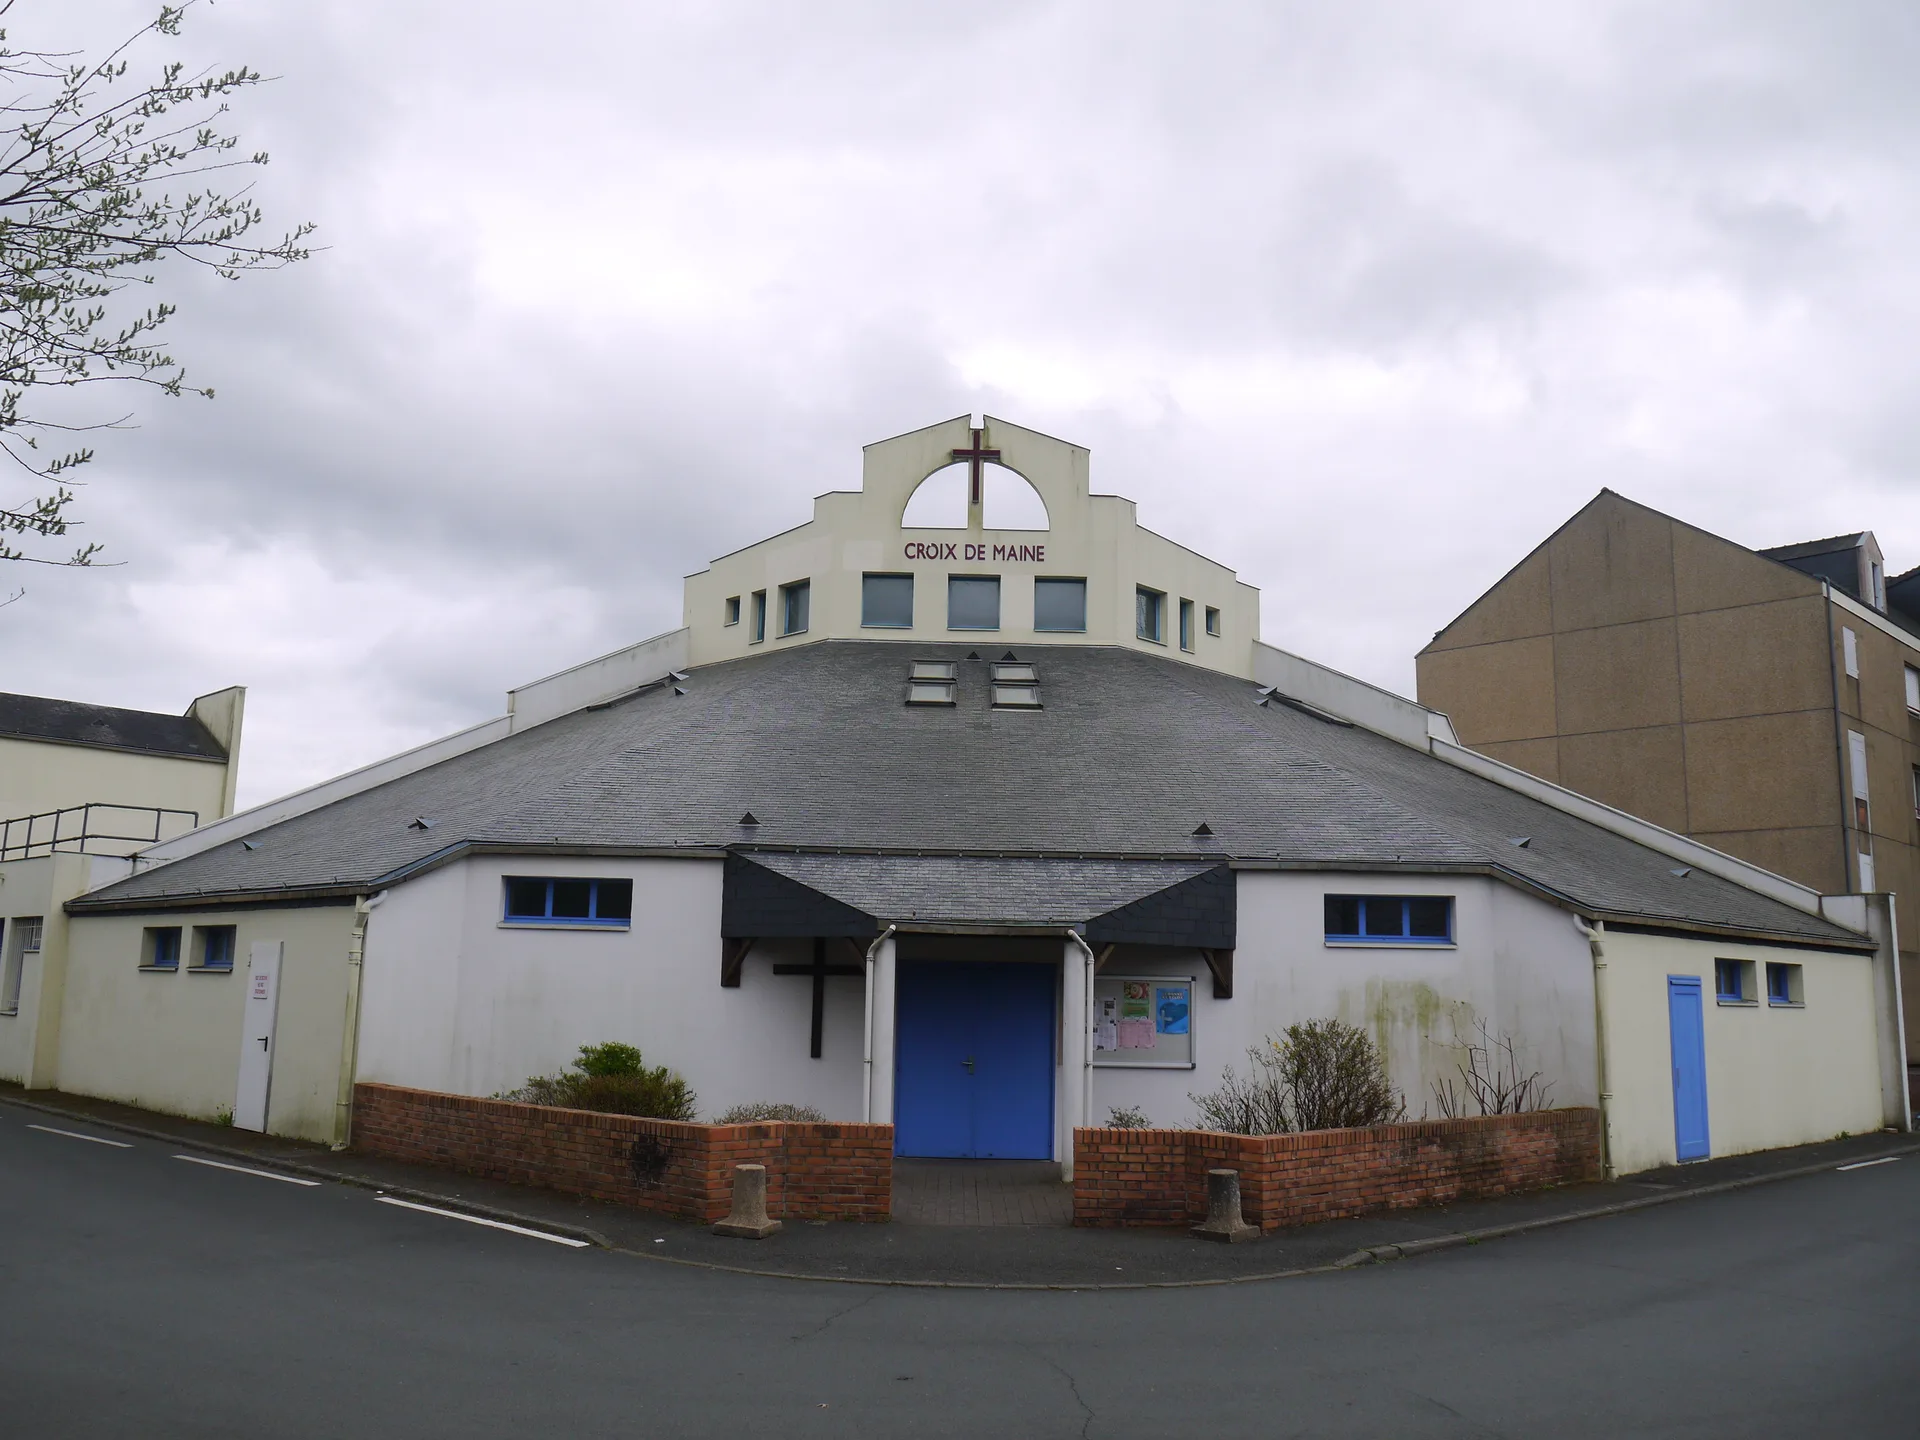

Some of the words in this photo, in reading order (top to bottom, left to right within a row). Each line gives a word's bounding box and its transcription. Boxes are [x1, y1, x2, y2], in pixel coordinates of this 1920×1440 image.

[904, 542, 957, 560] CROIX
[964, 544, 986, 560] DE
[993, 544, 1045, 562] MAINE
